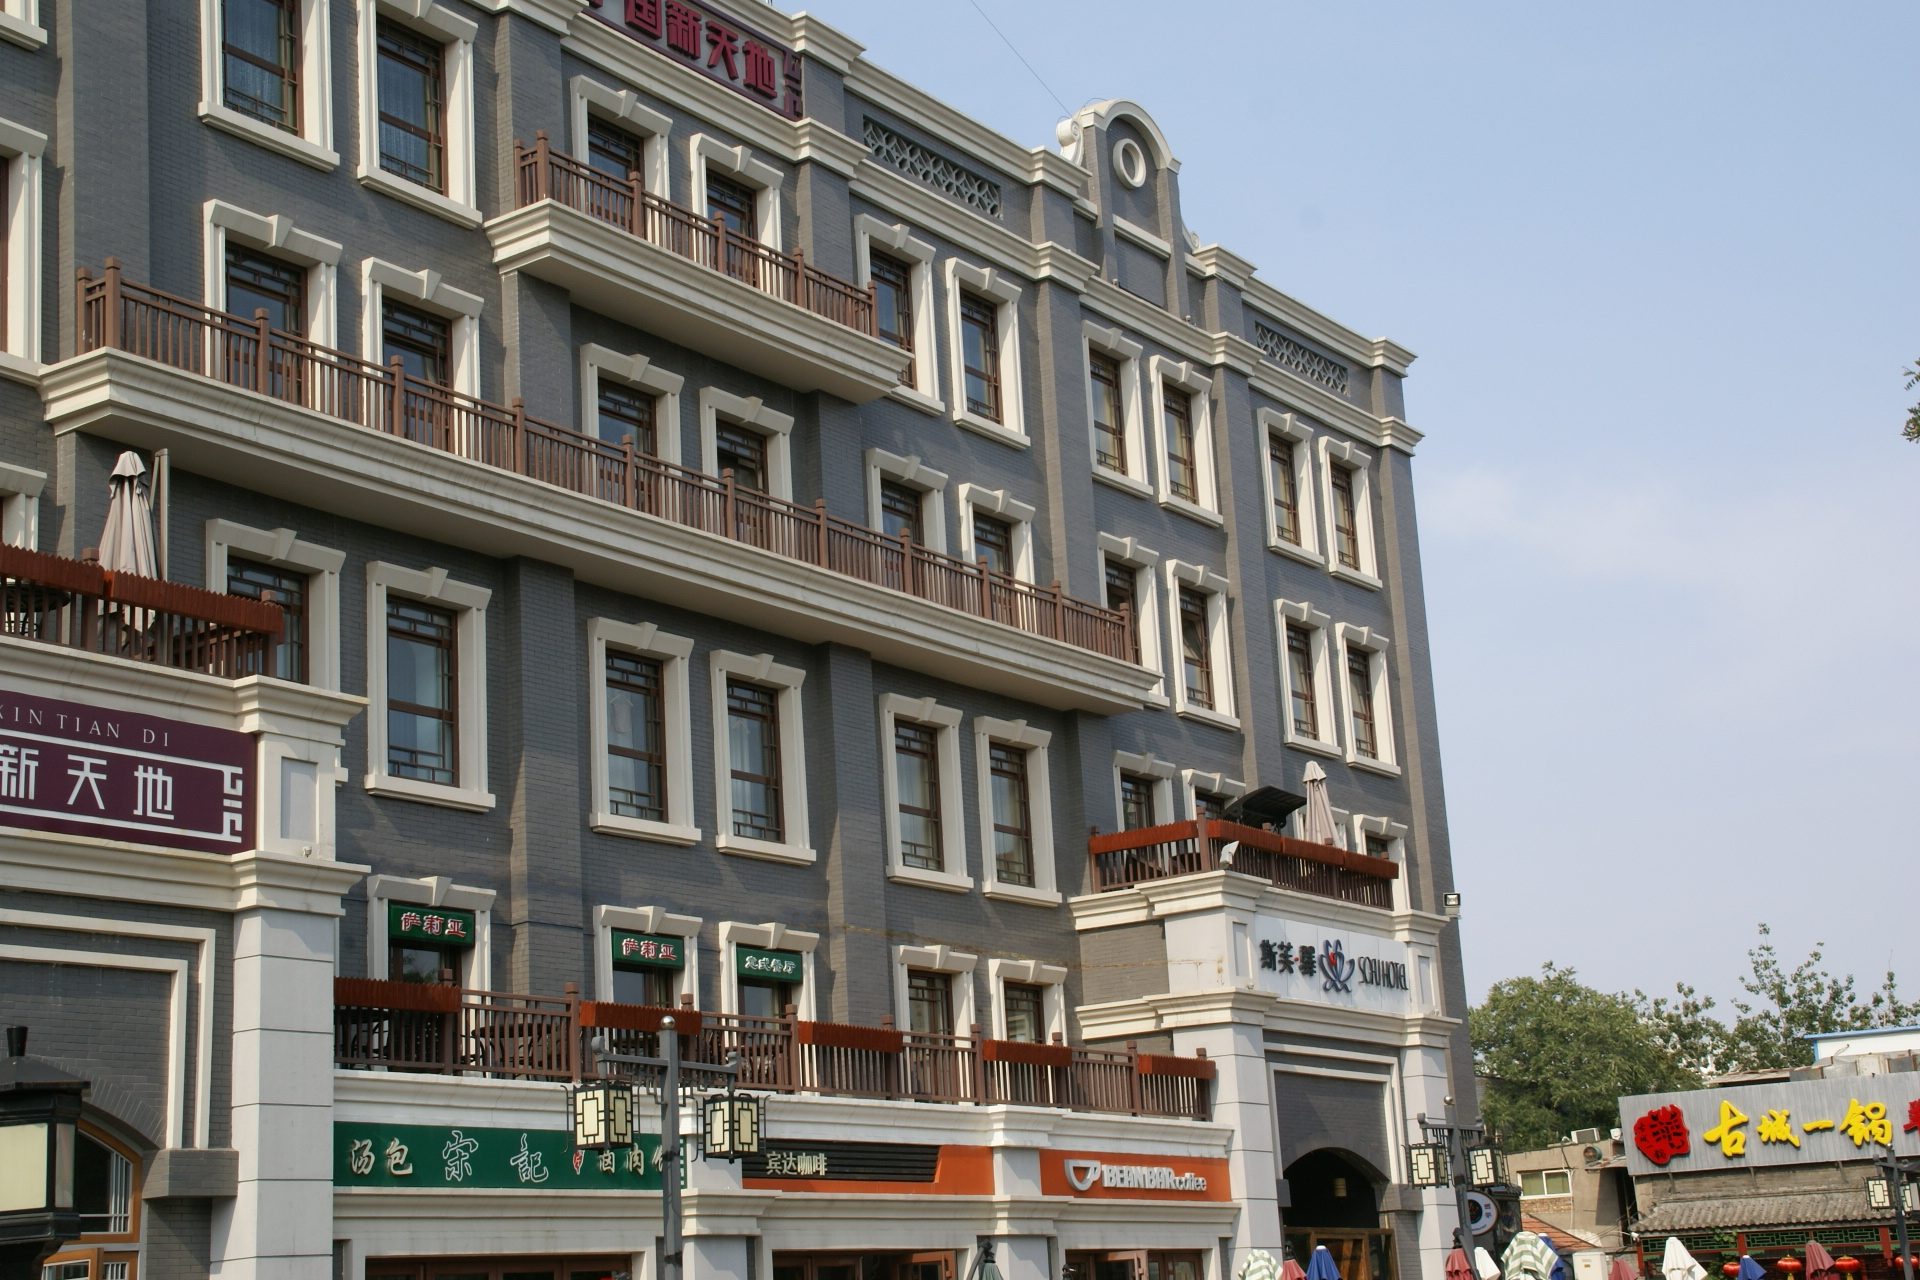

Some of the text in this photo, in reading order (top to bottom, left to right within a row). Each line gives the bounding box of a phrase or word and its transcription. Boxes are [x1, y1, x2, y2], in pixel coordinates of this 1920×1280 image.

[588, 0, 777, 99] 国新天地
[56, 713, 120, 739] TIAN
[143, 728, 169, 747] DI
[0, 744, 175, 820] 新天地
[401, 912, 466, 937] 萨莉亚
[622, 938, 677, 961] 萨莉亚
[745, 955, 797, 974] 意式餐厅
[1381, 960, 1409, 990] HOTEL
[1703, 1100, 1893, 1157] 古城一锅
[350, 1137, 413, 1175] 汤包
[766, 1151, 828, 1176] 宾达咖啡
